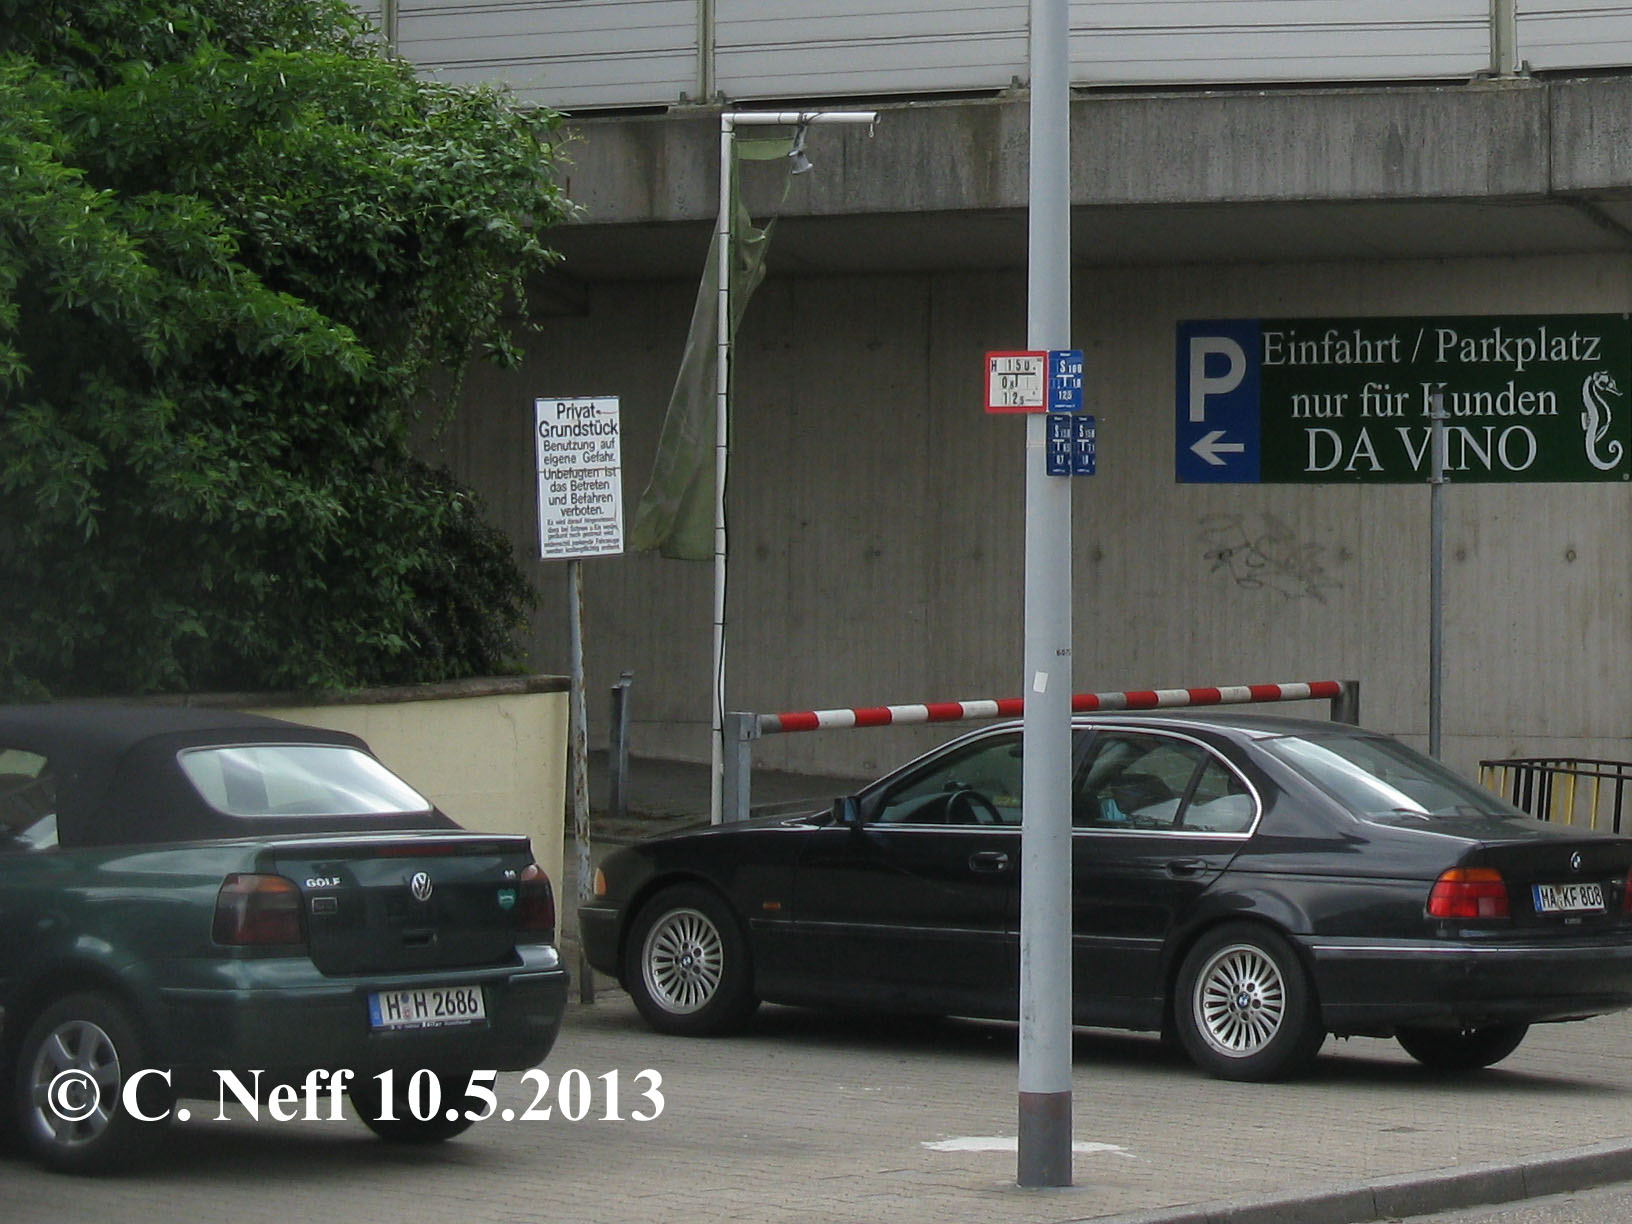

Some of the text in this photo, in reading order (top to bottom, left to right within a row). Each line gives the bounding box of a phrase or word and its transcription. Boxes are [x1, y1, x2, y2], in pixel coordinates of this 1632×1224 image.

[1262, 326, 1601, 372] Einfahrt / Parkplatz
[990, 360, 997, 372] H
[1189, 336, 1247, 423] P
[1291, 381, 1558, 419] nur für Kunden
[556, 402, 596, 420] Privat
[539, 418, 619, 438] Grundstück
[543, 437, 615, 453] Benutzung auf
[1304, 425, 1537, 472] DA VINO
[543, 450, 616, 467] eigene Gefahr.
[543, 467, 600, 481] Unbefugten
[550, 479, 610, 493] das Betreten
[548, 492, 614, 506] und Befahren
[560, 505, 605, 516] verboten.
[306, 877, 341, 887] GOLF
[1580, 885, 1602, 906] 808
[386, 989, 478, 1020] H H 2686
